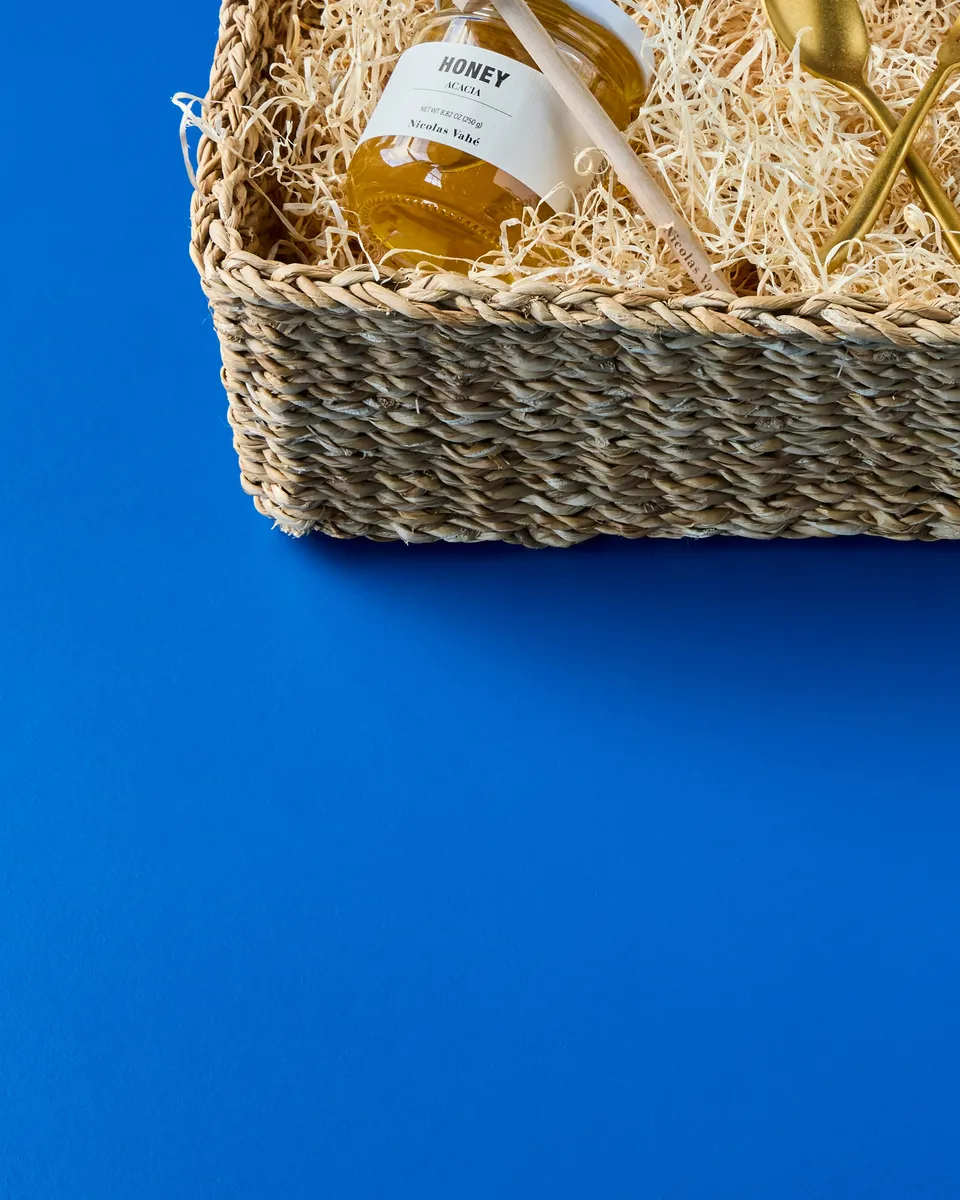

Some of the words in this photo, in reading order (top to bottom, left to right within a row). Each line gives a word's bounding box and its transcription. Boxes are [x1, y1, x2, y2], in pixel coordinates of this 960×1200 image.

[438, 56, 511, 89] HONEY
[444, 80, 481, 97] ACACIA
[408, 119, 449, 134] Nicolas
[452, 128, 480, 146] Vahé
[440, 109, 454, 118] 8.82
[454, 112, 463, 120] OZ
[462, 115, 476, 126] (250
[476, 121, 483, 129] g)
[664, 226, 700, 274] Nicolas
